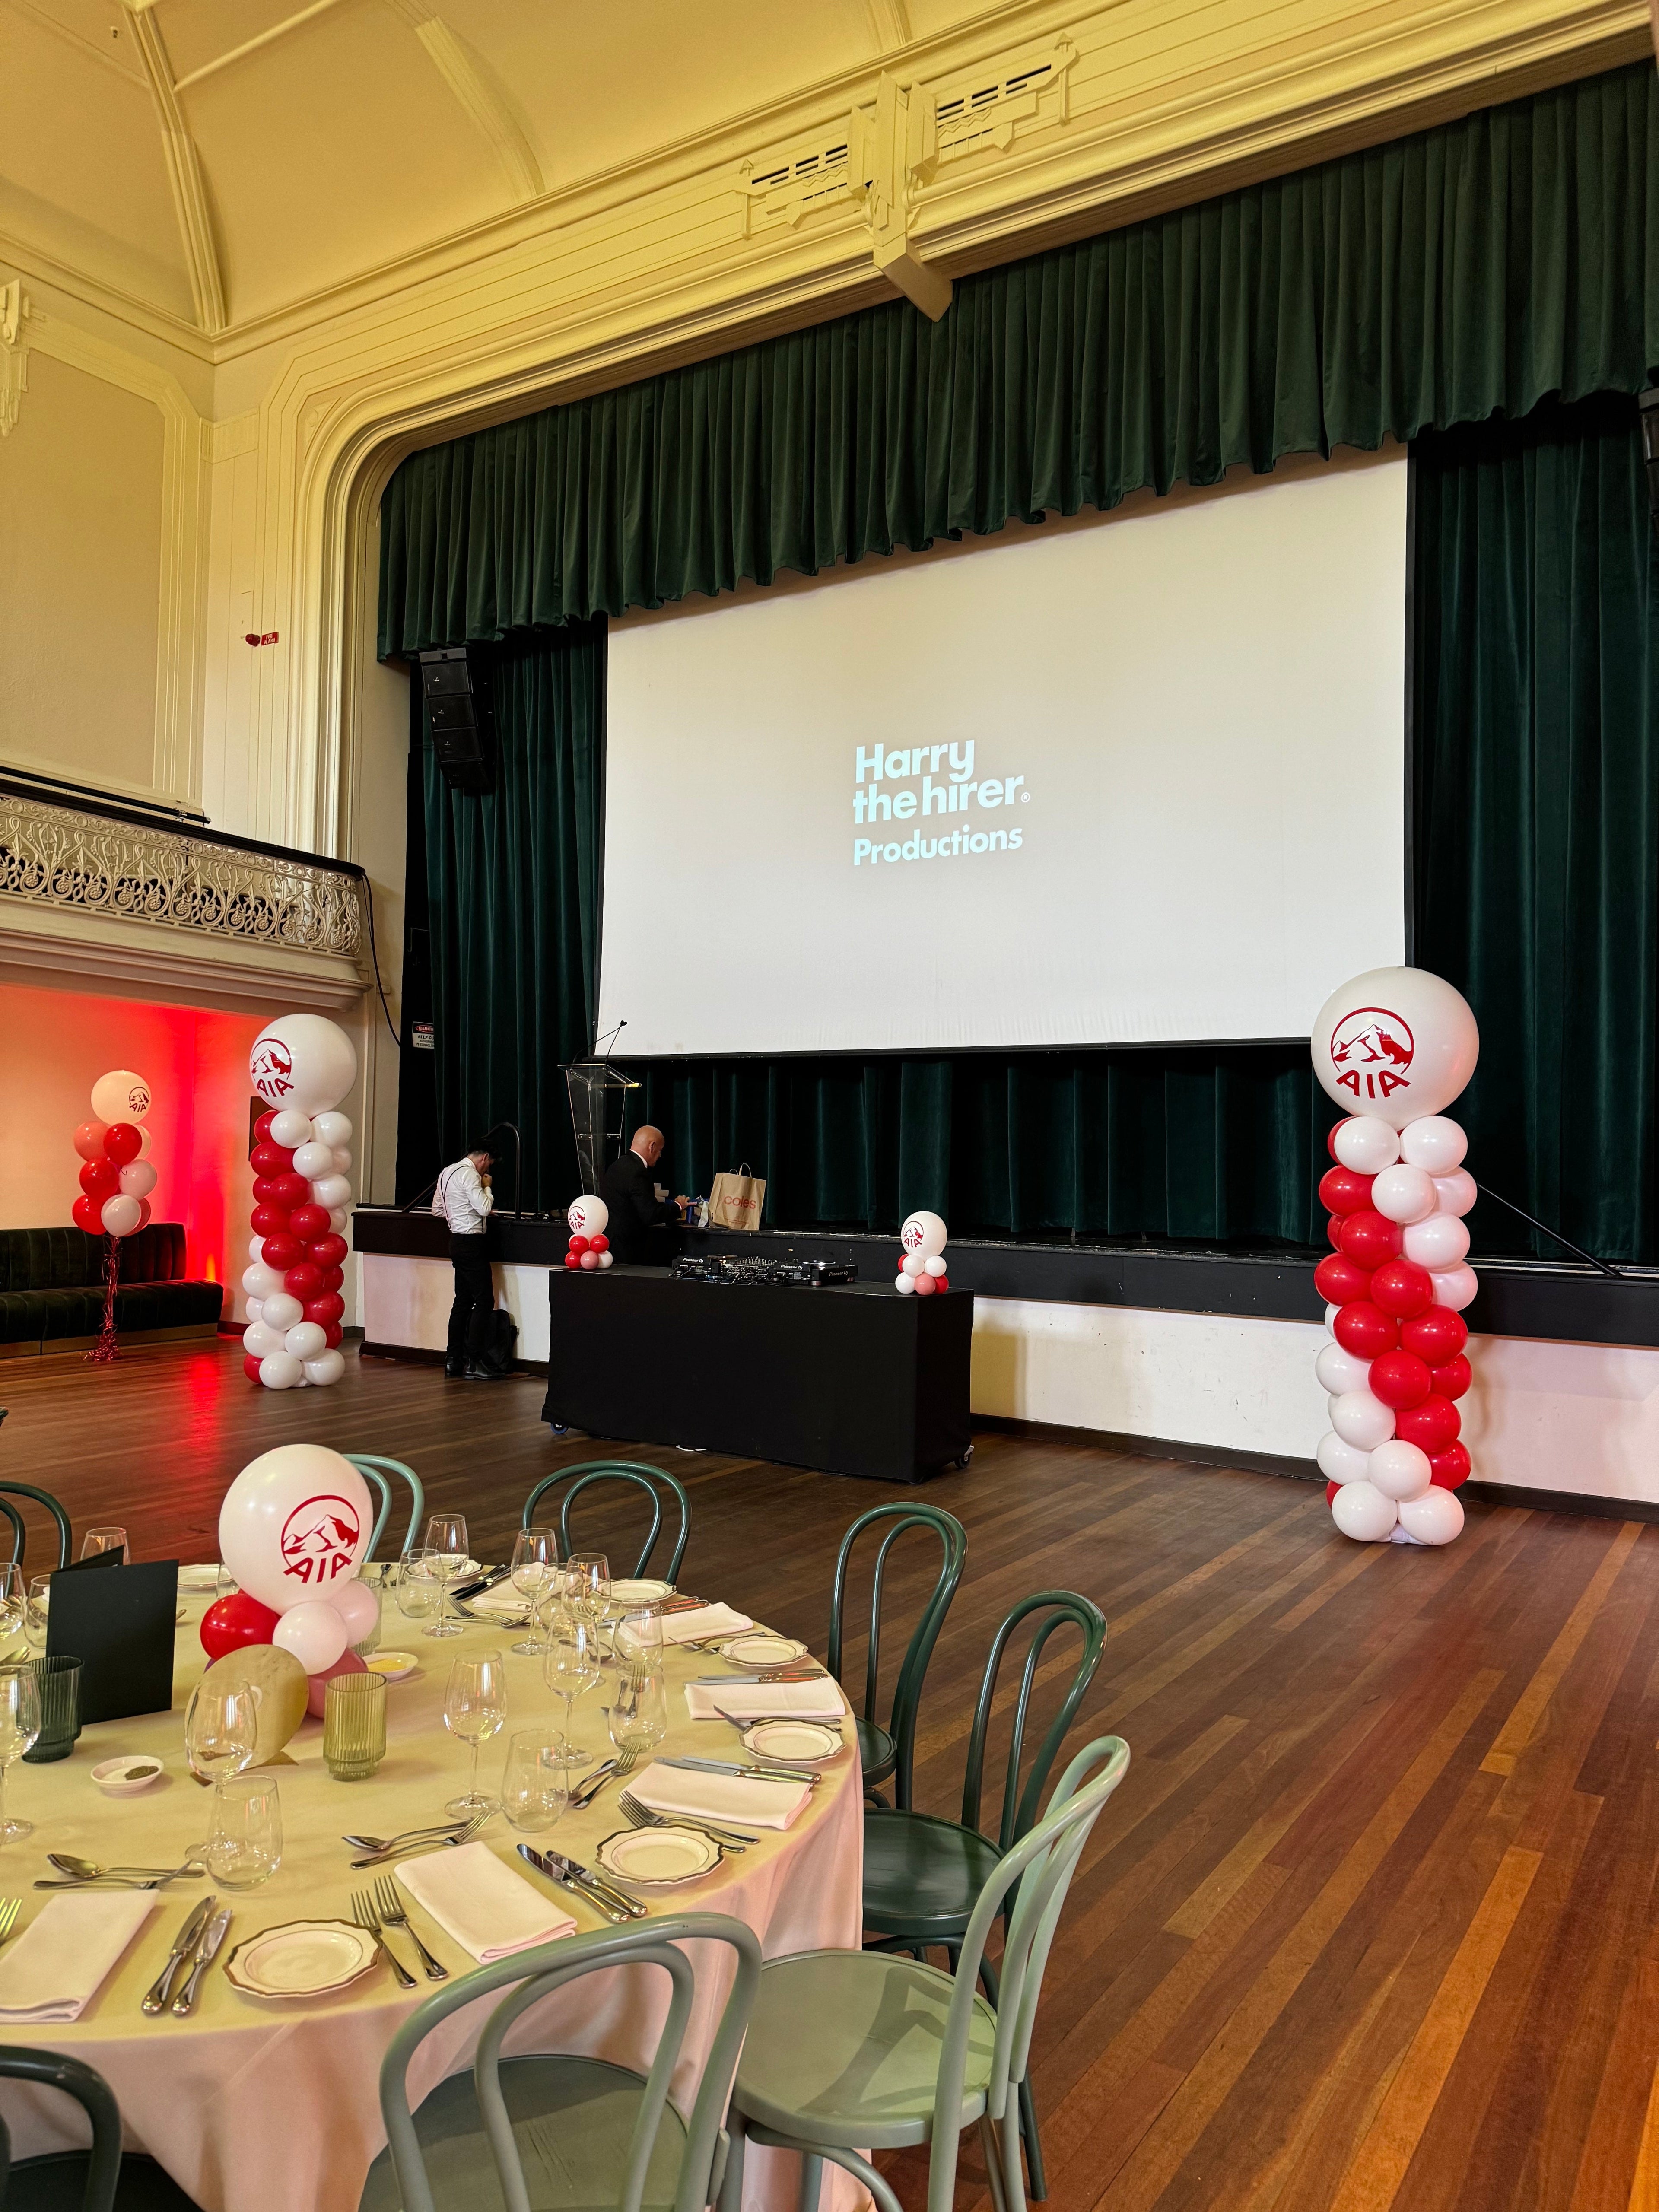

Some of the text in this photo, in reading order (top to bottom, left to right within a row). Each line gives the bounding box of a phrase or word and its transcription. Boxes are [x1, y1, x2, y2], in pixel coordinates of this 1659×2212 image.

[855, 739, 975, 783] Harry
[853, 783, 917, 824] the
[854, 824, 1023, 866] Productions
[257, 1078, 295, 1097] AIA
[1335, 1070, 1411, 1099] AIA
[129, 1103, 146, 1112] AIA
[724, 1196, 756, 1209] coles
[570, 1221, 585, 1230] AIA
[904, 1238, 922, 1248] AIA
[283, 1552, 353, 1584] AIA
